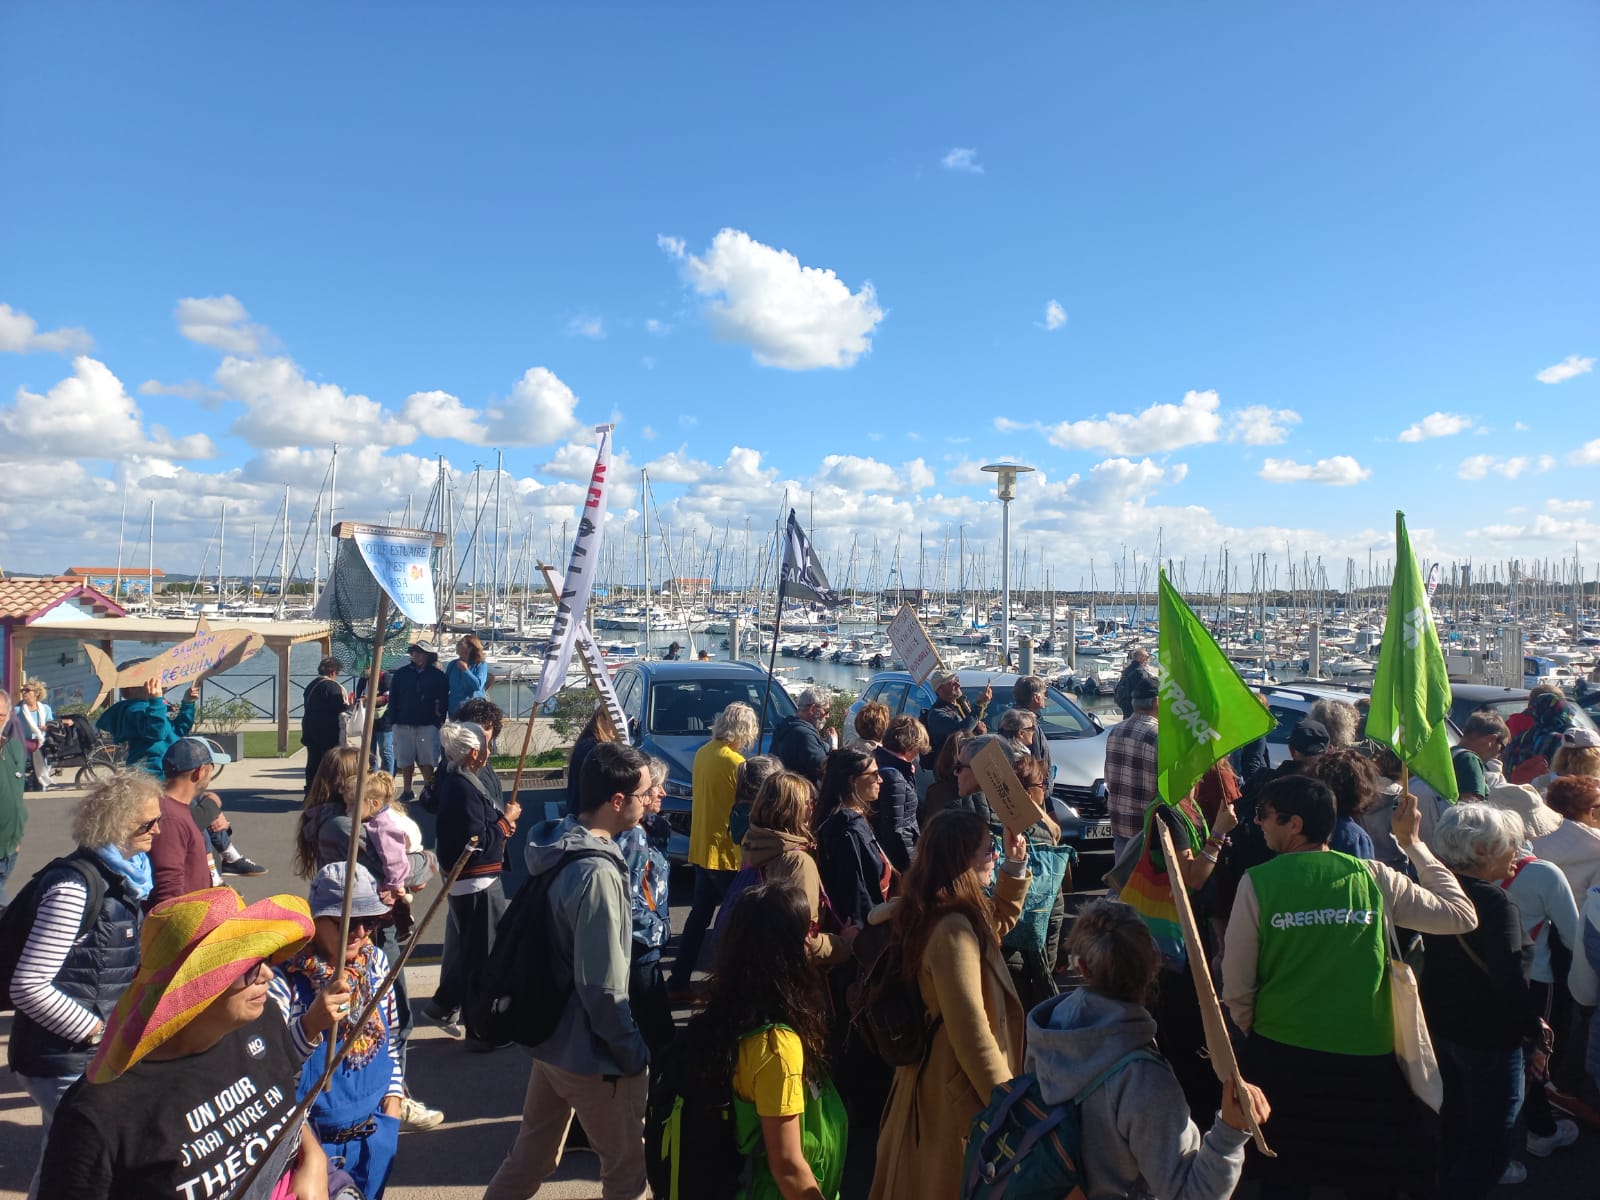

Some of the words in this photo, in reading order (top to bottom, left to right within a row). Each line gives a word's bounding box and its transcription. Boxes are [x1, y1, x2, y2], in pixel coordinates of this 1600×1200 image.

[390, 544, 428, 558] ESTUAIRE
[172, 635, 215, 657] SAUMON
[1271, 908, 1377, 931] GREENPEACE
[248, 1038, 263, 1053] NO
[185, 1102, 216, 1133] UN
[214, 1076, 257, 1117] JOUR
[181, 1130, 224, 1167] J'IRAI
[223, 1100, 267, 1138] VIVRE
[264, 1086, 284, 1108] EN
